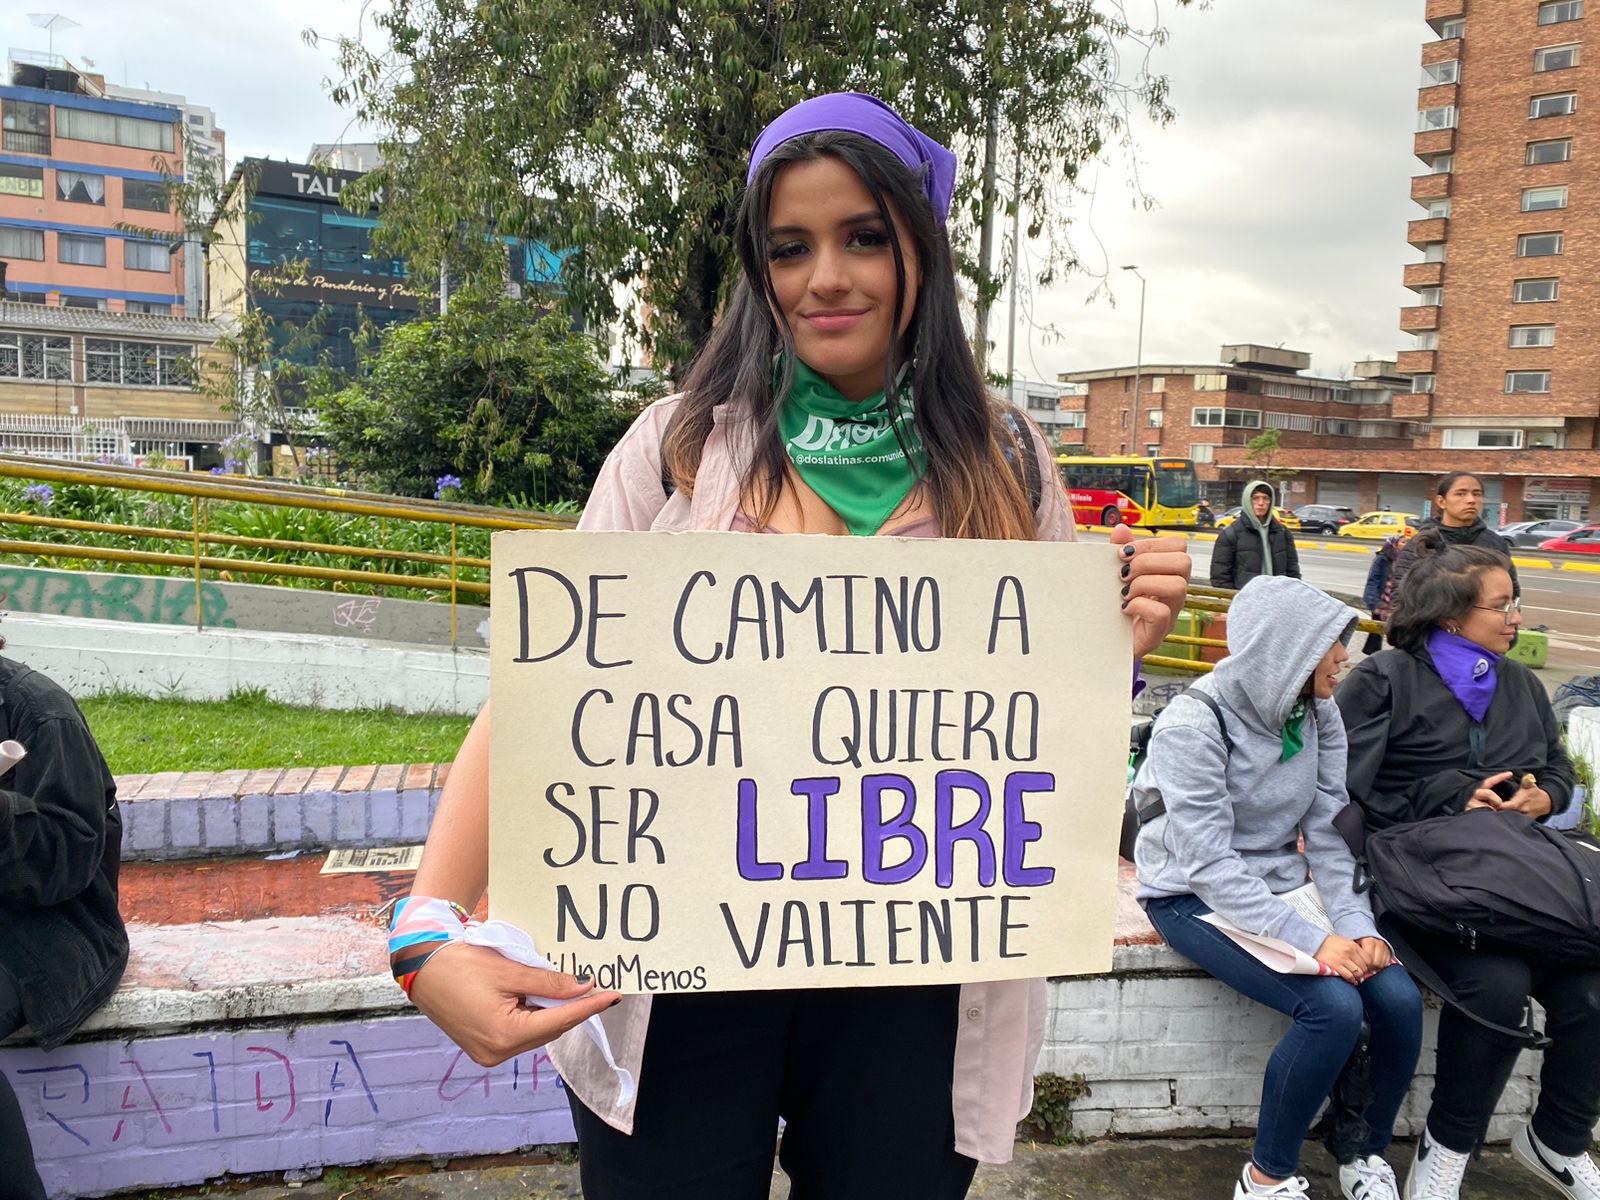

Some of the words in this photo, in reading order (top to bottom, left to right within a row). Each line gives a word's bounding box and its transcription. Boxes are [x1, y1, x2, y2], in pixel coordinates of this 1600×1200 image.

[507, 566, 633, 669] DE
[673, 570, 941, 665] CAMINO
[987, 575, 1031, 656] A
[571, 688, 743, 769] CASA
[812, 685, 1039, 769] QUIERO
[542, 781, 667, 868] SER
[735, 769, 1056, 889] LIBRE
[556, 883, 660, 943] NO
[718, 895, 1031, 969] VALIENTE
